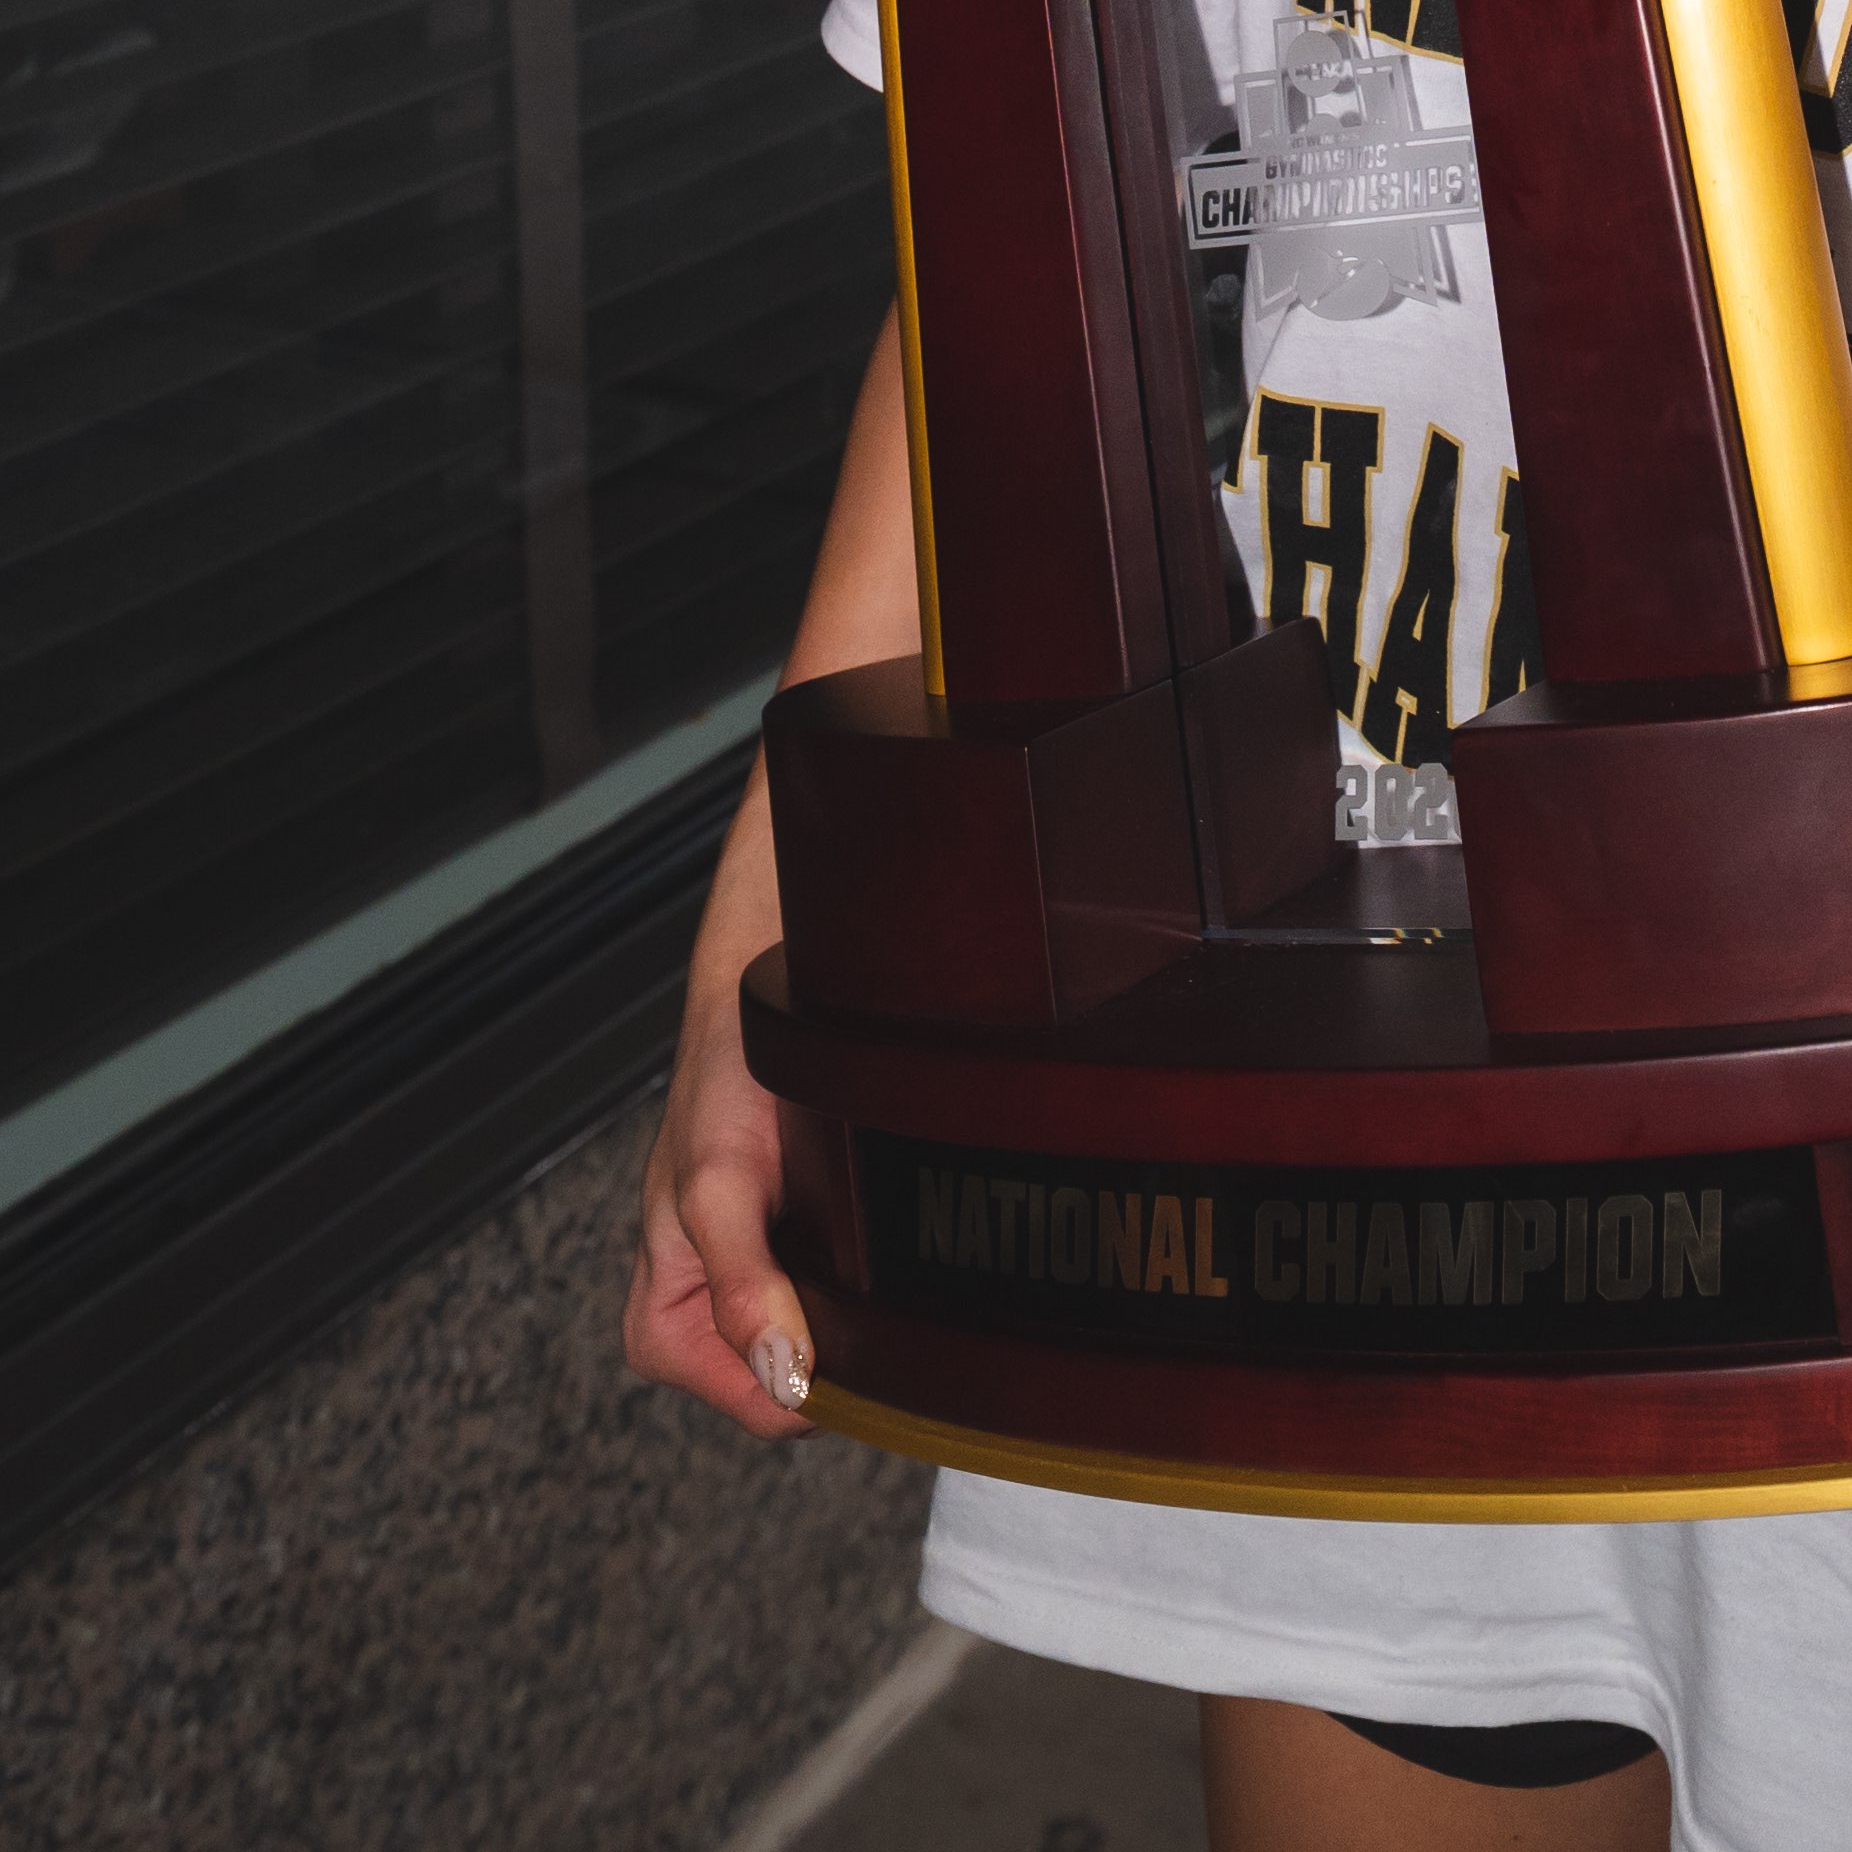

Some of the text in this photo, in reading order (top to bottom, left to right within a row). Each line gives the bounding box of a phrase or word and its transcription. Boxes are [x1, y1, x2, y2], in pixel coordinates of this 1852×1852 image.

[1201, 164, 1464, 230] CHAMPIONSHIPS
[917, 1166, 1723, 1307] NATIONAL CHAMPION
